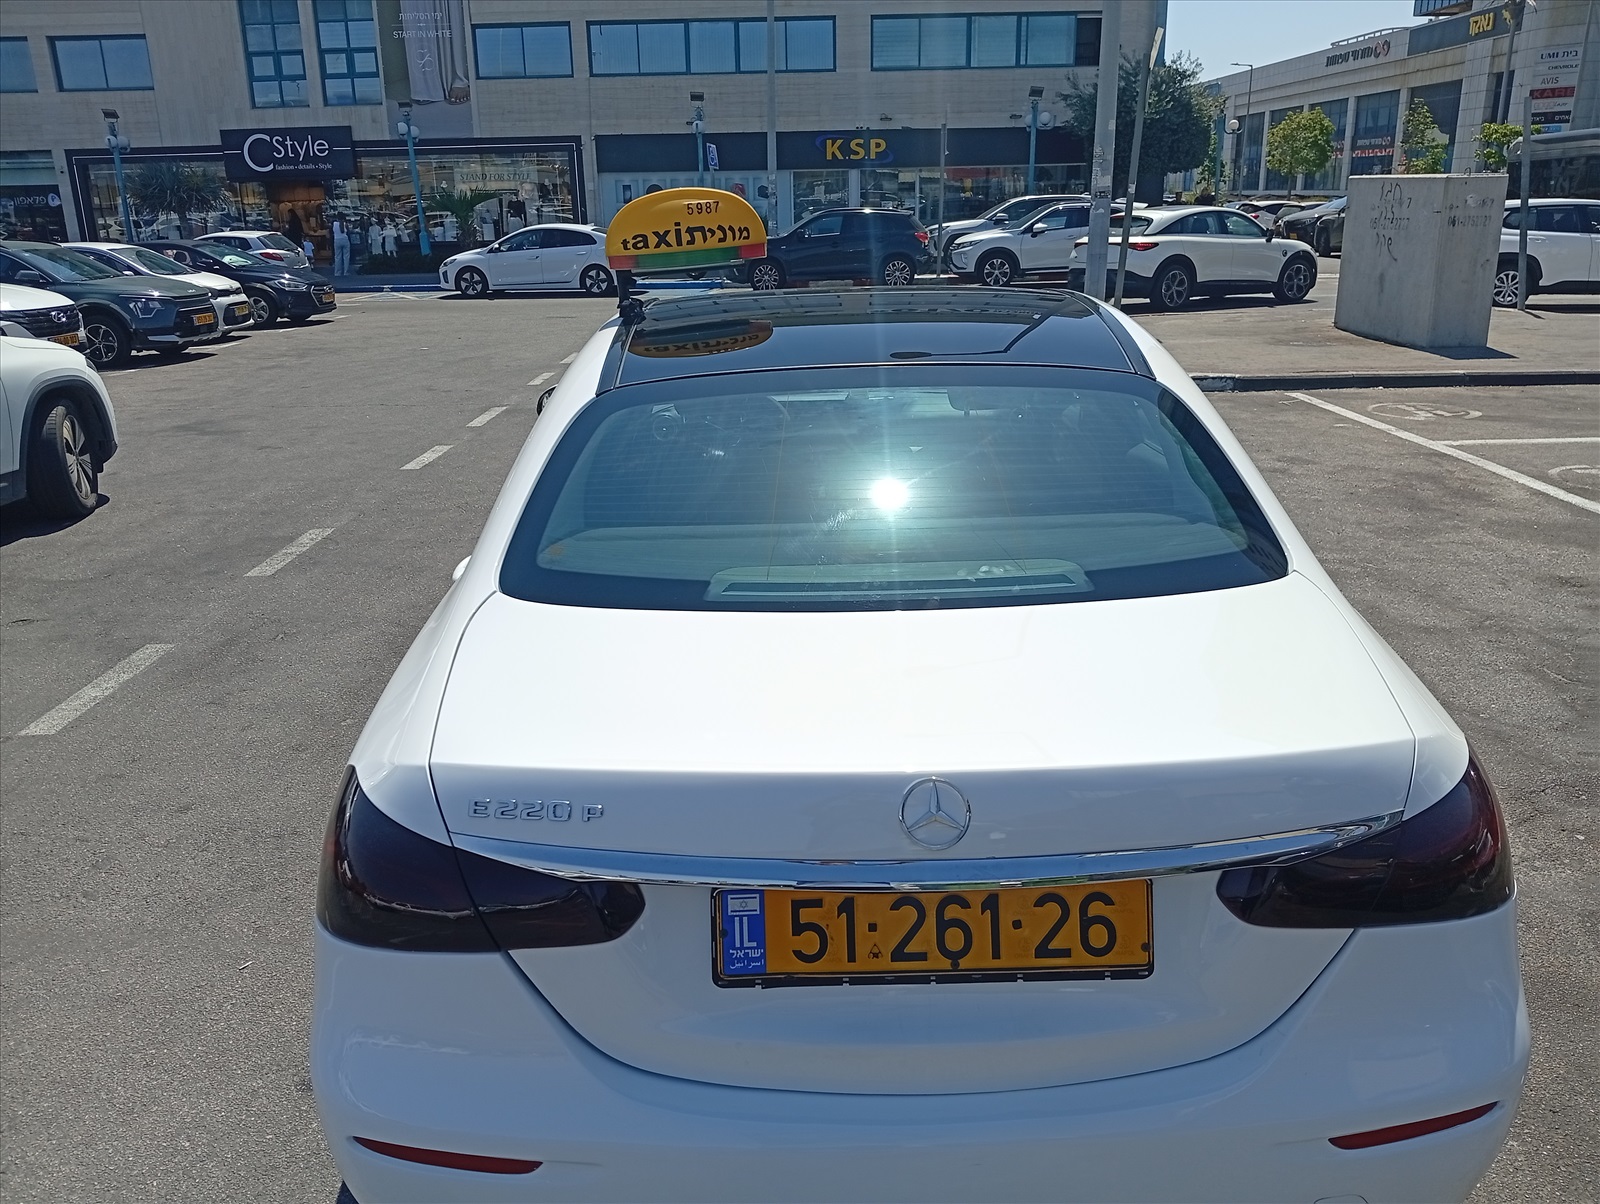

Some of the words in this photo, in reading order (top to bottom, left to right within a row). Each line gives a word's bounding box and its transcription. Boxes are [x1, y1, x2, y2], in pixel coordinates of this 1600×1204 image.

[398, 12, 431, 21] הסליחות
[392, 30, 416, 38] START
[417, 30, 426, 38] IN
[427, 30, 452, 38] WHITE
[1540, 51, 1559, 60] UMI
[1561, 50, 1578, 58] בית
[1547, 63, 1580, 71] CHEVROLE
[1540, 76, 1559, 86] AVIS
[826, 138, 887, 160] K.S.P
[275, 163, 295, 171] fashion
[297, 162, 316, 171] details
[318, 162, 333, 171] Style
[459, 172, 487, 181] STAND
[489, 172, 505, 181] FOR
[13, 196, 47, 206] פלאפון
[686, 201, 720, 215] 5987
[620, 222, 683, 251] taxi
[684, 224, 751, 246] מונית
[467, 798, 572, 822] E220
[734, 916, 758, 948] IL
[729, 948, 764, 959] ישראל
